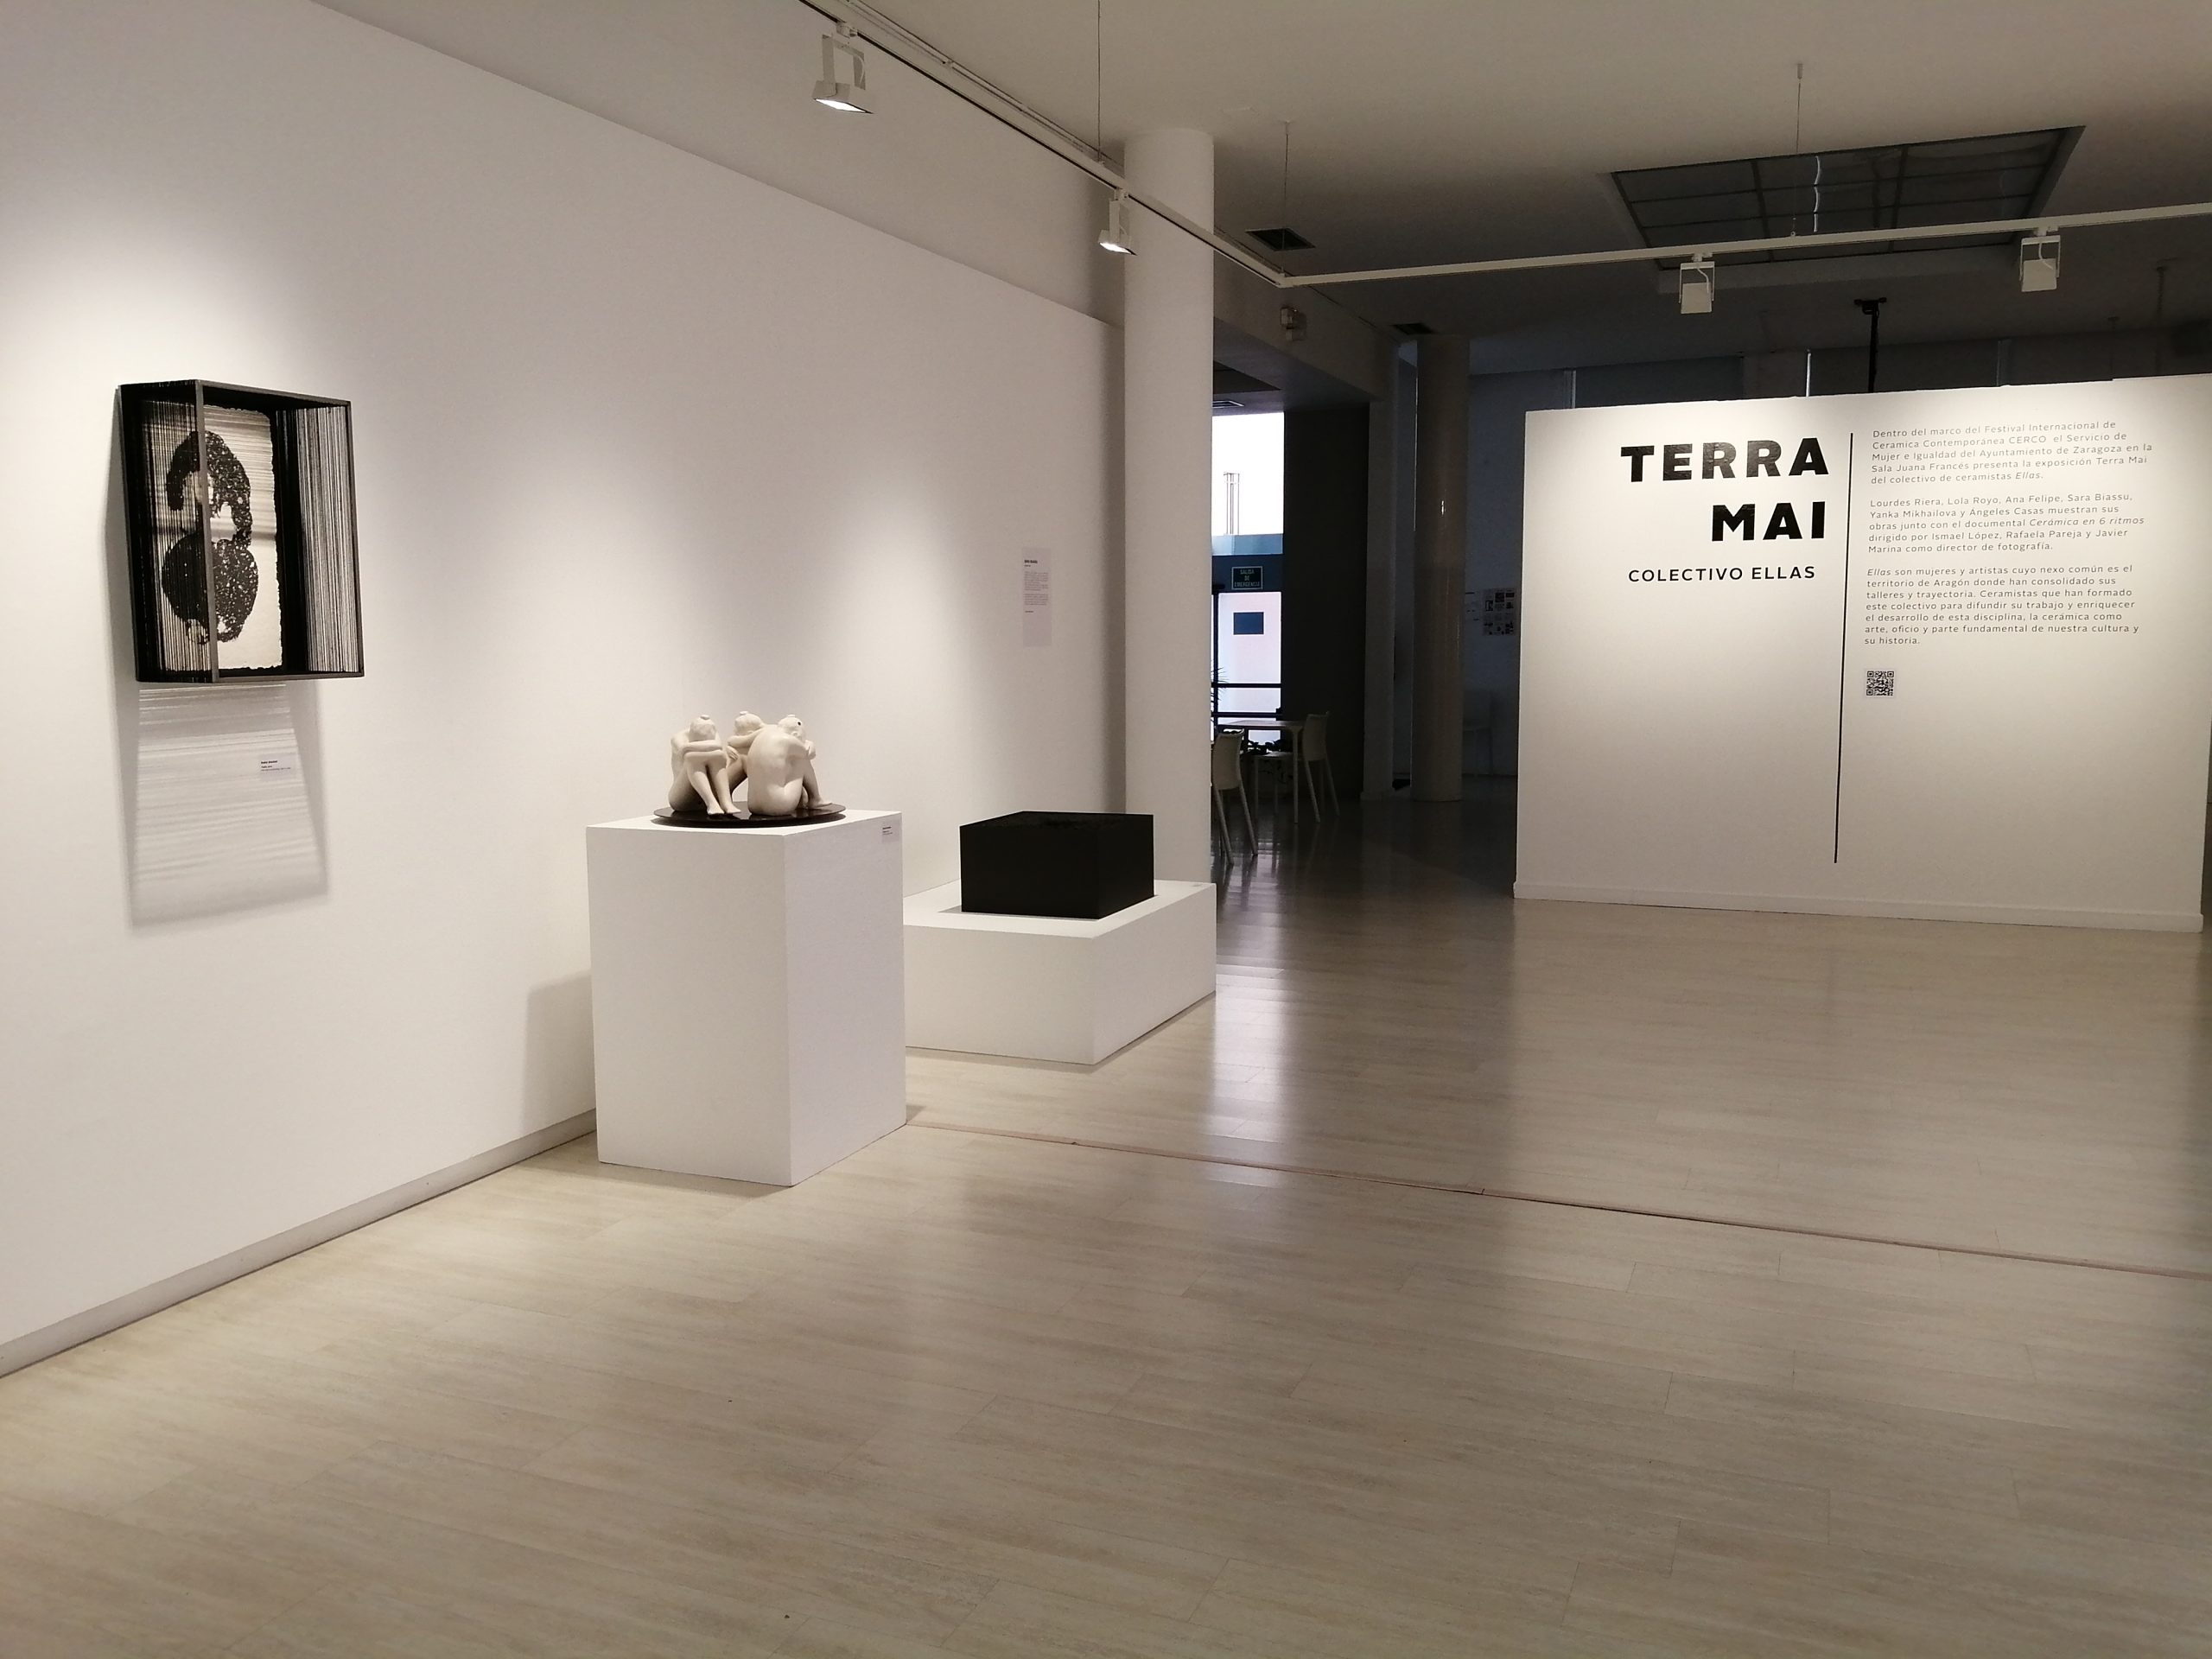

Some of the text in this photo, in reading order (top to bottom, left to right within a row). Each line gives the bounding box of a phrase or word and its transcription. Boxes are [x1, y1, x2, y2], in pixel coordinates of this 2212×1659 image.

[1872, 429, 1908, 438] Dentro
[1910, 428, 1927, 436] del
[1965, 426, 1980, 435] del
[1985, 424, 2025, 434] Festival
[2029, 421, 2099, 432] Internacional
[2102, 420, 2115, 429] de
[2053, 435, 2063, 443] el
[2066, 433, 2110, 442] Servicio
[2113, 432, 2126, 441] de
[1872, 452, 1900, 462] Mujer
[1913, 450, 1956, 461] Igualdad
[1960, 449, 1975, 458] del
[1979, 447, 2052, 459] Ayuntamiento
[2056, 446, 2069, 454] de
[2073, 444, 2122, 455] Zaragoza
[1621, 438, 1828, 482] TERRA
[1872, 464, 1892, 473] Sala
[1896, 462, 1925, 472] Juana
[1929, 461, 1969, 471] Francés
[1973, 460, 2018, 471] presenta
[2035, 457, 2092, 468] exposición
[2095, 456, 2124, 465] Terra
[2128, 455, 2147, 464] Mai
[1871, 471, 2044, 484] del colectivo de ceramistas Ellas.
[1870, 499, 1910, 507] Lourdes
[1914, 498, 1944, 507] Riera,
[1948, 497, 1969, 505] Lola
[1973, 496, 2001, 506] Royo,
[2005, 495, 2024, 504] Ana
[2028, 494, 2063, 505] Felipe,
[2067, 493, 2090, 502] Sara
[1870, 510, 1899, 518] Yanka
[1903, 509, 1956, 518] Mikhailova
[1960, 510, 1966, 518] y
[1969, 506, 2010, 518] Ángeles
[2013, 506, 2044, 515] Casas
[2048, 505, 2097, 514] muestran
[1712, 501, 1825, 541] MAI
[1869, 521, 1897, 530] obras
[1900, 521, 1927, 531] junto
[1964, 518, 2025, 528] documental
[2029, 518, 2079, 527] Cerámica
[2099, 517, 2106, 525] 6
[2109, 516, 2145, 525] ritmos
[1868, 533, 1907, 543] dirigido
[1910, 534, 1929, 543] por
[1931, 532, 1964, 541] Ismael
[1968, 531, 2002, 542] López,
[2005, 531, 2044, 539] Rafaela
[2049, 530, 2082, 540] Pareja
[2095, 529, 2128, 537] Javier
[1868, 544, 1902, 553] Marina
[1936, 543, 1977, 552] director
[1981, 543, 1993, 551] de
[1998, 542, 2053, 552] fotografía.
[1629, 566, 1815, 582] COLECTIVO ELLAS
[1867, 568, 1891, 576] Ellas
[1916, 567, 1956, 577] mujeres
[1968, 566, 2008, 575] artistas
[2068, 565, 2103, 574] común
[1866, 579, 1914, 588] territorio
[1934, 578, 1970, 588] Aragón
[2031, 577, 2094, 586] consolidado
[1866, 590, 1904, 599] talleres
[1916, 590, 1976, 600] trayectoria.
[1980, 589, 2037, 598] Ceramistas
[2088, 588, 2132, 597] formado
[1891, 601, 1937, 610] colectivo
[2026, 601, 2064, 611] trabajo
[2076, 601, 2135, 610] enriquecer
[1974, 613, 2025, 622] disciplina,
[2029, 613, 2038, 621] la
[1865, 626, 1888, 634] arte,
[1931, 626, 1959, 634] parte
[1962, 625, 2027, 633] fundamental
[2031, 625, 2044, 633] de
[2048, 625, 2088, 633] nuestra
[2091, 625, 2129, 633] cultura
